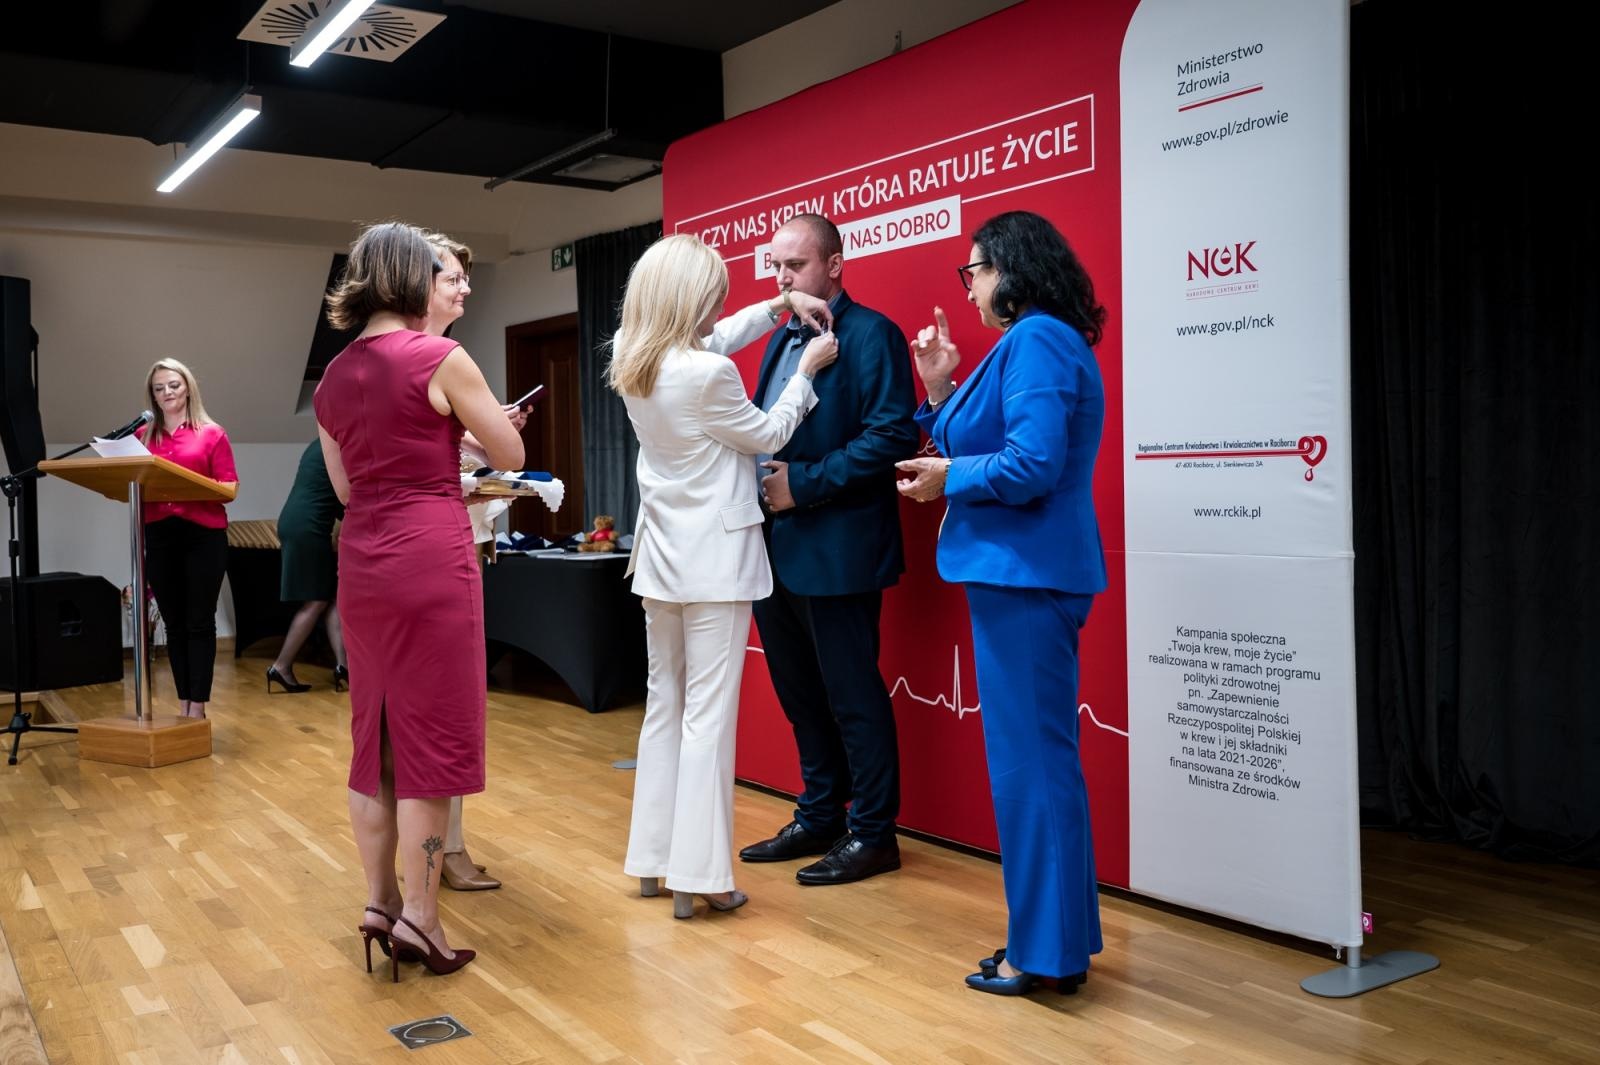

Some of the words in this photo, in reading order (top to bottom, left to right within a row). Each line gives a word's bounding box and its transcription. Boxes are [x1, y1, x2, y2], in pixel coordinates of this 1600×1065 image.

[1177, 43, 1264, 77] Ministerstwo
[1177, 71, 1230, 97] Zdrowia
[1161, 110, 1289, 151] www.gov.pl/zdrowie
[694, 221, 731, 249] CZY
[733, 212, 767, 243] NAS
[832, 175, 905, 217] KTÓRA
[909, 146, 995, 195] RATUJE
[1001, 121, 1079, 172] ŻYCIE
[849, 225, 882, 251] NAS
[886, 208, 951, 243] DOBRO
[1216, 285, 1242, 294] CENTRUM
[1176, 313, 1275, 337] www.gov.pl/nck
[1138, 442, 1164, 453] Regionalne
[1164, 441, 1185, 451] Centrum
[1185, 440, 1220, 450] Krwiodawstwa
[1269, 437, 1297, 448] Raciborzu
[1193, 504, 1262, 520] www.rckik.pl
[1176, 625, 1228, 641] Kampania
[1230, 631, 1287, 647] społeczna
[1168, 639, 1201, 656] „Twoja
[1203, 643, 1231, 658] krew,
[1234, 647, 1261, 662] moje
[1148, 653, 1208, 669] realizowana
[1210, 660, 1220, 671] w
[1222, 661, 1263, 676] ramach
[1266, 666, 1321, 681] programu
[1183, 672, 1219, 688] polityki
[1221, 676, 1281, 696] zdrowotnej
[1188, 687, 1204, 700] pn.
[1207, 688, 1280, 709] „Zapewnienie
[1177, 700, 1290, 725] samowystarczalności
[1167, 712, 1255, 739] Rzeczypospolitej
[1257, 725, 1302, 745] Polskiej
[1180, 731, 1189, 741] w
[1191, 731, 1216, 745] krew
[1218, 733, 1222, 747] i
[1223, 735, 1237, 751] jej
[1239, 739, 1288, 757] składniki
[1182, 746, 1195, 757] na
[1197, 746, 1217, 761] lata
[1169, 756, 1234, 778] finansowana
[1237, 770, 1251, 781] ze
[1253, 771, 1302, 790] środków
[1188, 773, 1229, 792] Ministra
[1232, 781, 1280, 802] Zdrowia.
